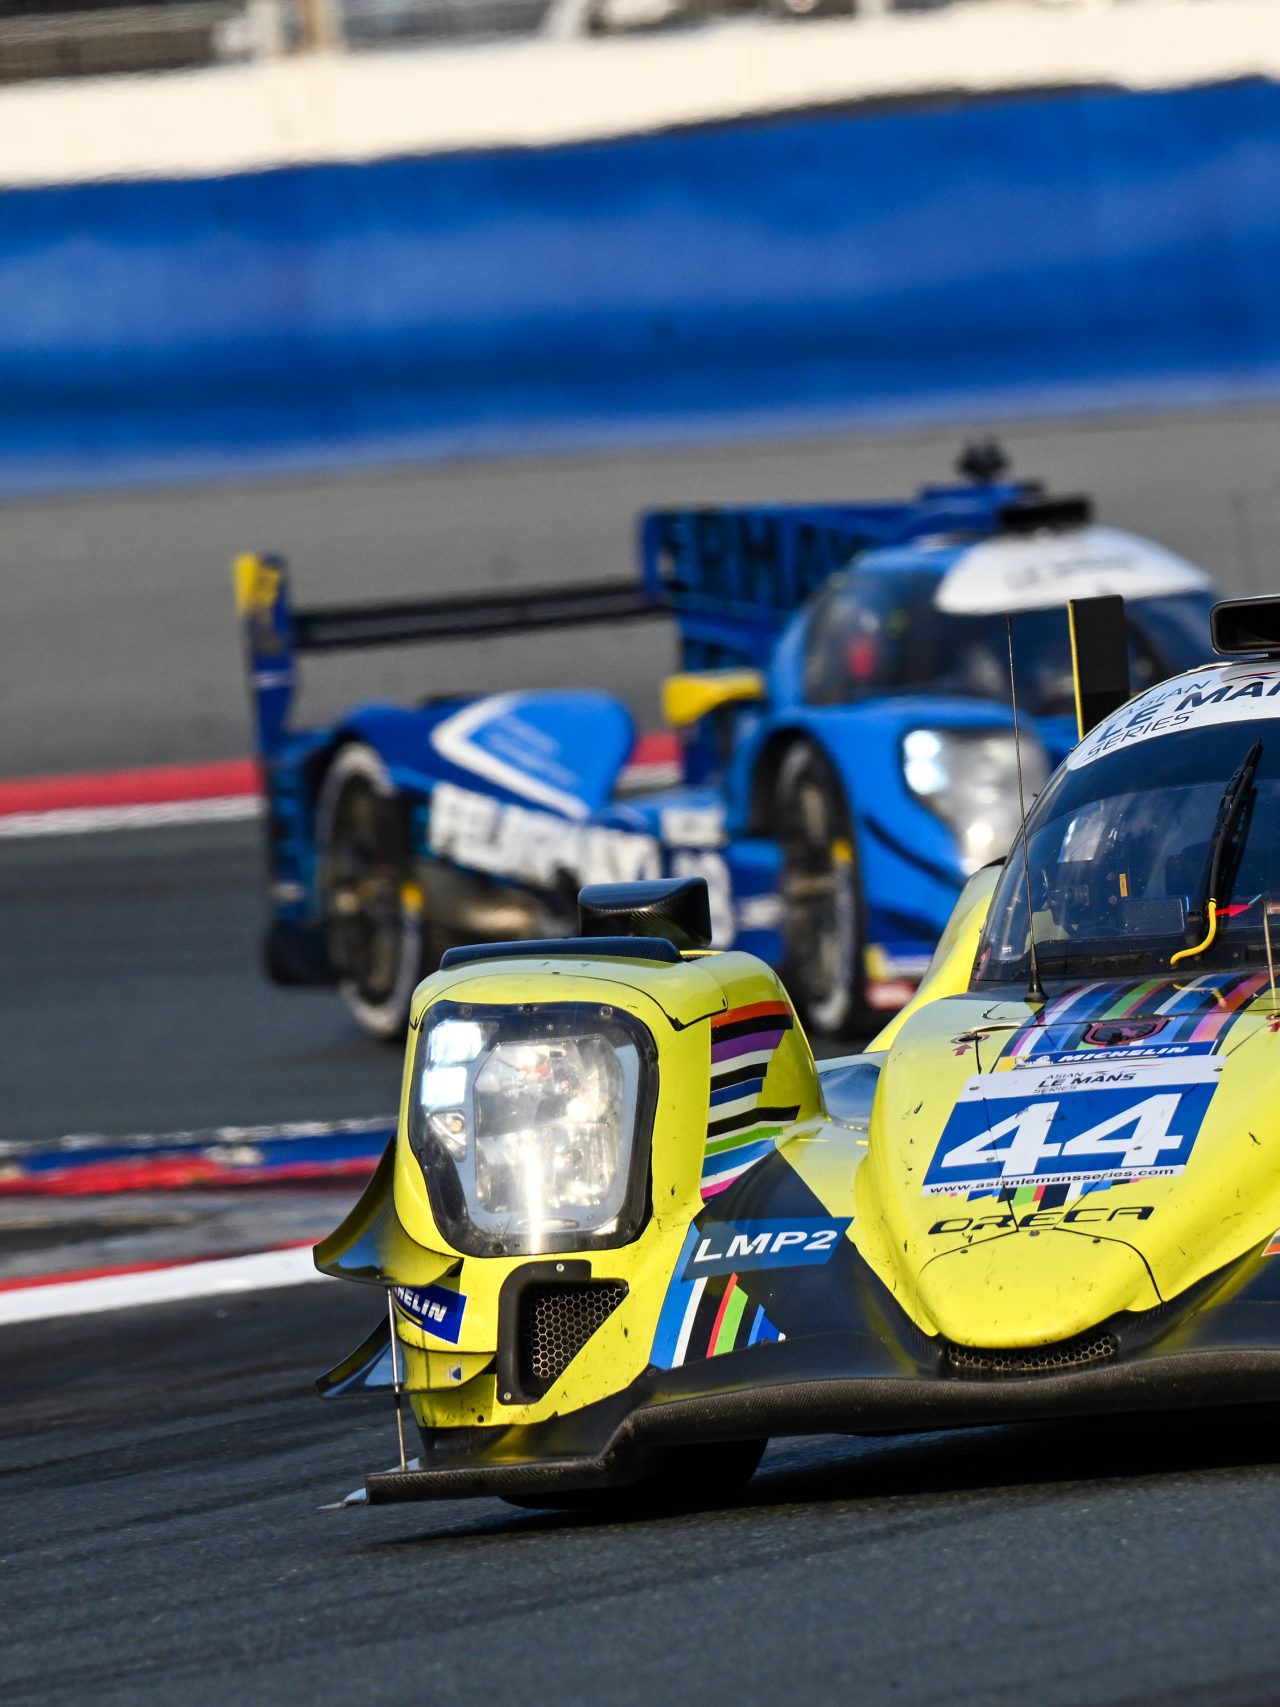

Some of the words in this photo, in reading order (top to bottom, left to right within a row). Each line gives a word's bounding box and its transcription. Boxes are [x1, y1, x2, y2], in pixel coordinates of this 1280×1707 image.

[1087, 710, 1195, 757] SERIES
[1097, 702, 1164, 743] LE
[1057, 1046, 1190, 1063] MICHELIN
[1038, 1077, 1069, 1088] LE
[1071, 1072, 1137, 1085] MANS
[940, 1093, 1183, 1177] 44
[930, 1167, 1174, 1194] www.asianlemansseries.com
[928, 1206, 1155, 1235] ORECA
[693, 1229, 838, 1263] LMP2
[394, 1286, 448, 1322] HELIN
